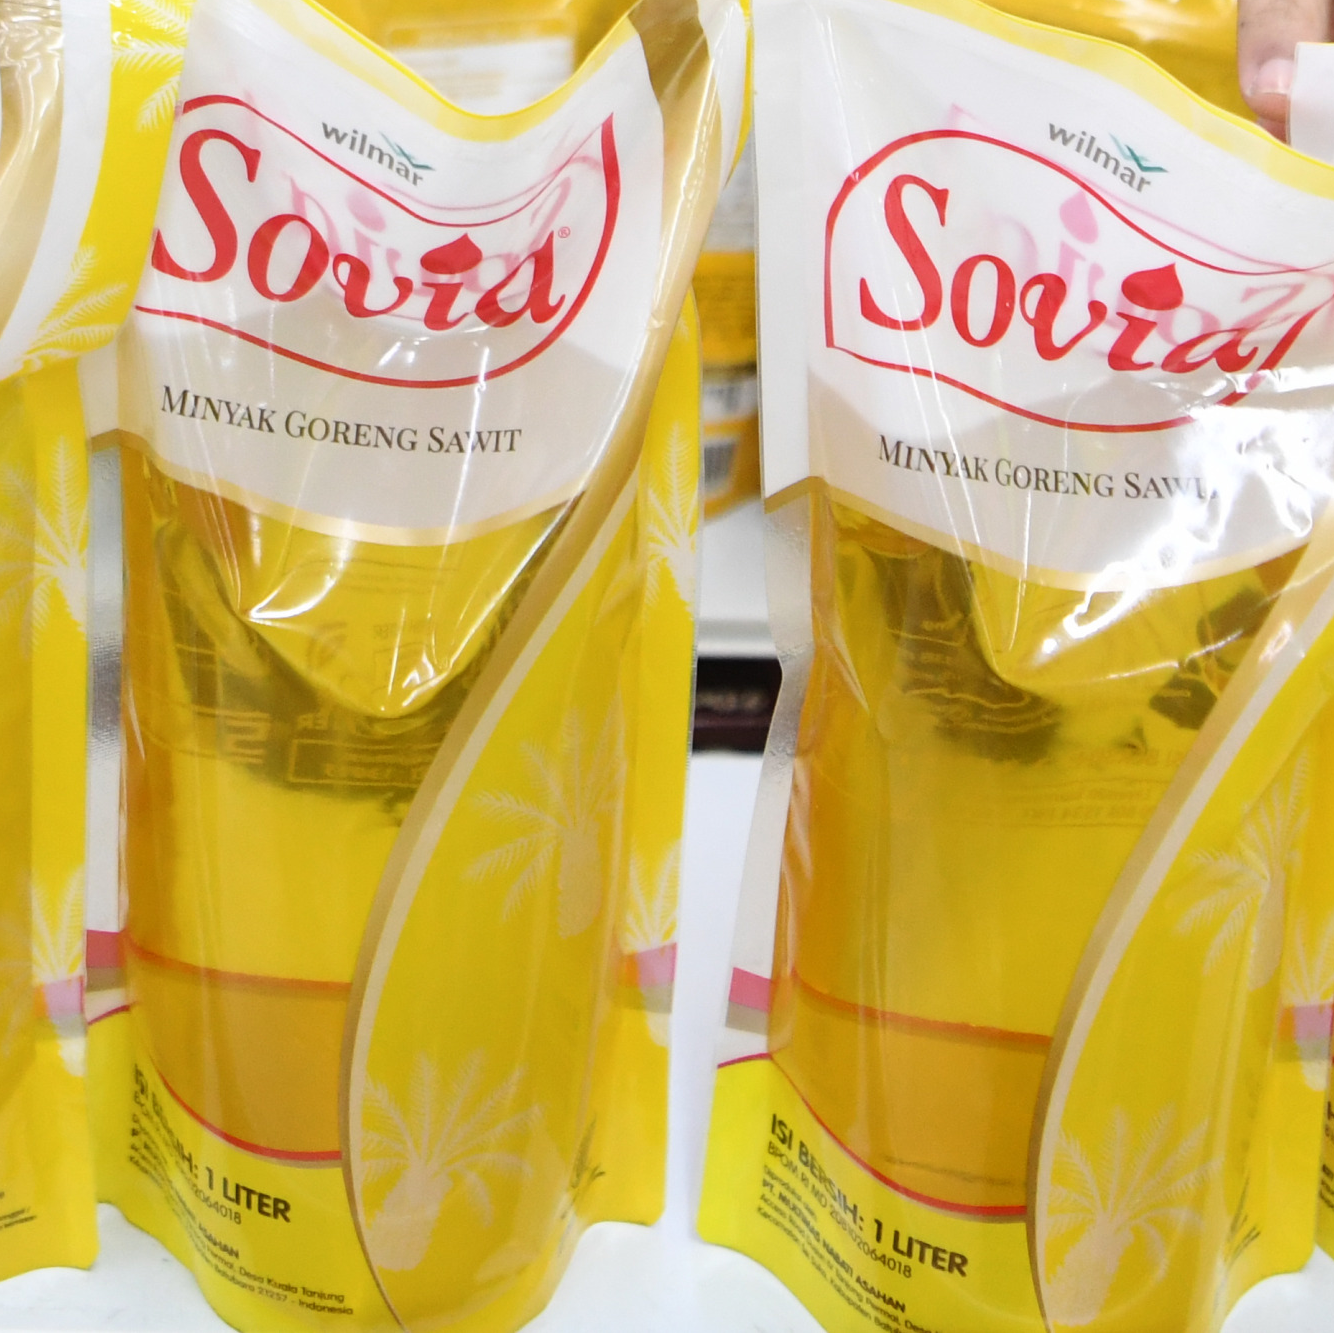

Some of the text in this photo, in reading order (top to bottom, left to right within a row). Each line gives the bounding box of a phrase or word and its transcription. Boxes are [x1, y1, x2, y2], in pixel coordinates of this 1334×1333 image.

[322, 121, 424, 186] wilmar
[1049, 122, 1151, 193] wilmar
[151, 128, 567, 331] Sovia
[859, 173, 1271, 374] Sovia
[161, 384, 522, 454] MINYAK GORENG SAWIT
[878, 434, 989, 482] MINYAK
[995, 458, 1114, 498] GORENG
[205, 1166, 214, 1191] 1
[222, 1176, 292, 1223] LITER
[770, 1112, 794, 1151] ISI
[873, 1217, 883, 1244] 1
[892, 1229, 969, 1278] LITER
[298, 1298, 354, 1316] Indonesia
[301, 1286, 346, 1304] Tanjung
[855, 1274, 907, 1314] ASAHAN
